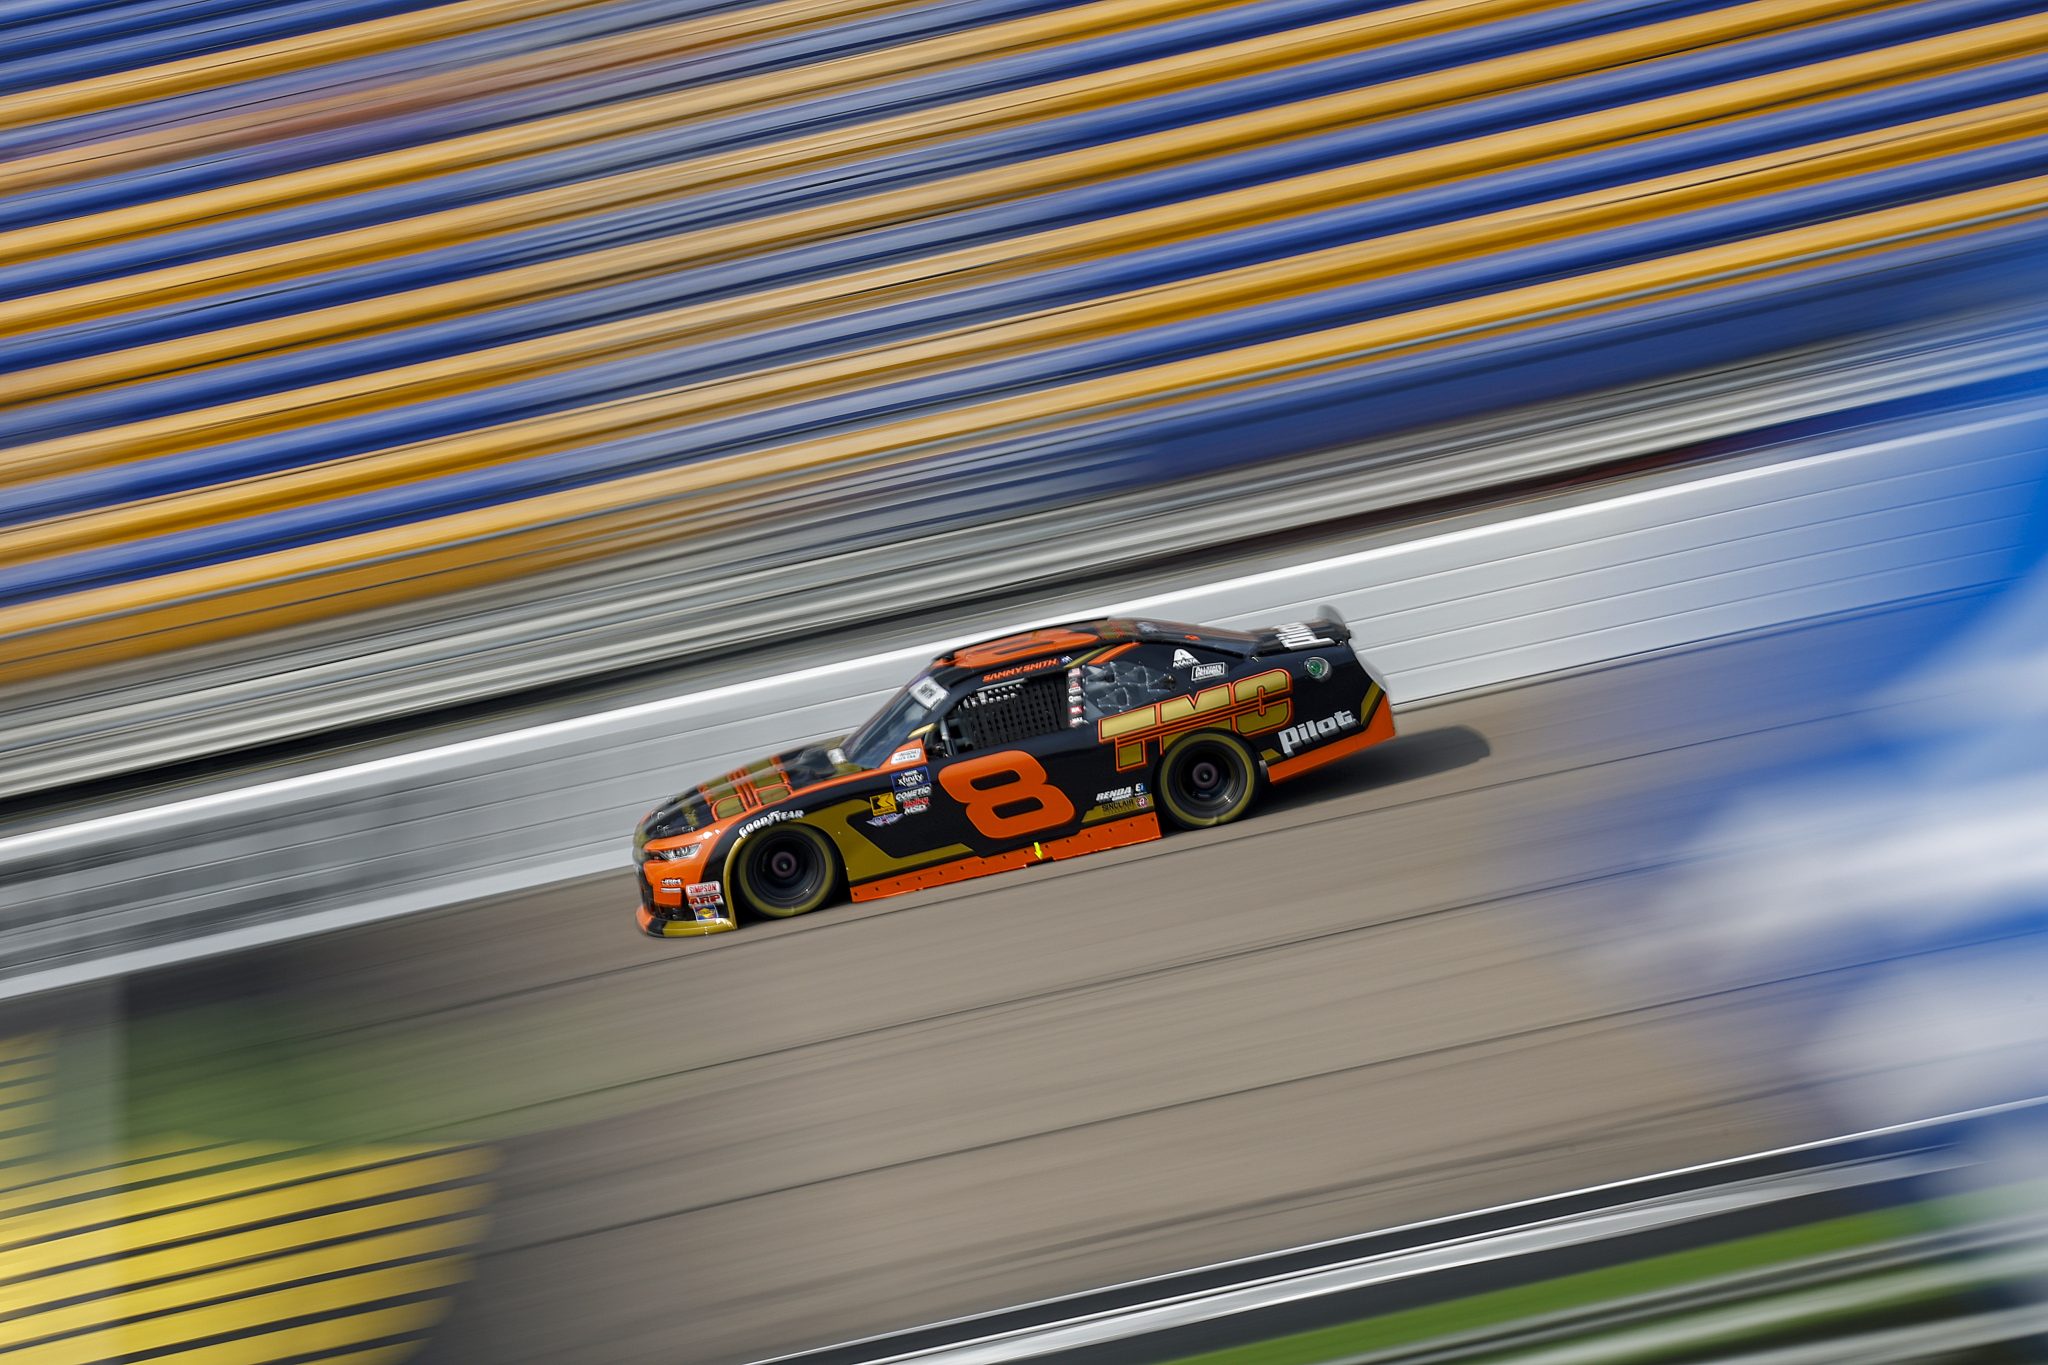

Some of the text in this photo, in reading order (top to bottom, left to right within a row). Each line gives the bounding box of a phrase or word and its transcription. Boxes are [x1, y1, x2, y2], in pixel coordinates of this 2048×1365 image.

[982, 658, 1057, 683] SAMMY SMITH
[1098, 668, 1293, 773] TMC
[895, 786, 932, 801] COMETIC
[938, 750, 1076, 839] 8
[1095, 786, 1132, 802] RENDA
[738, 810, 804, 838] GOODYEAR
[688, 884, 717, 894] SIMPSON
[689, 894, 721, 905] ARP
